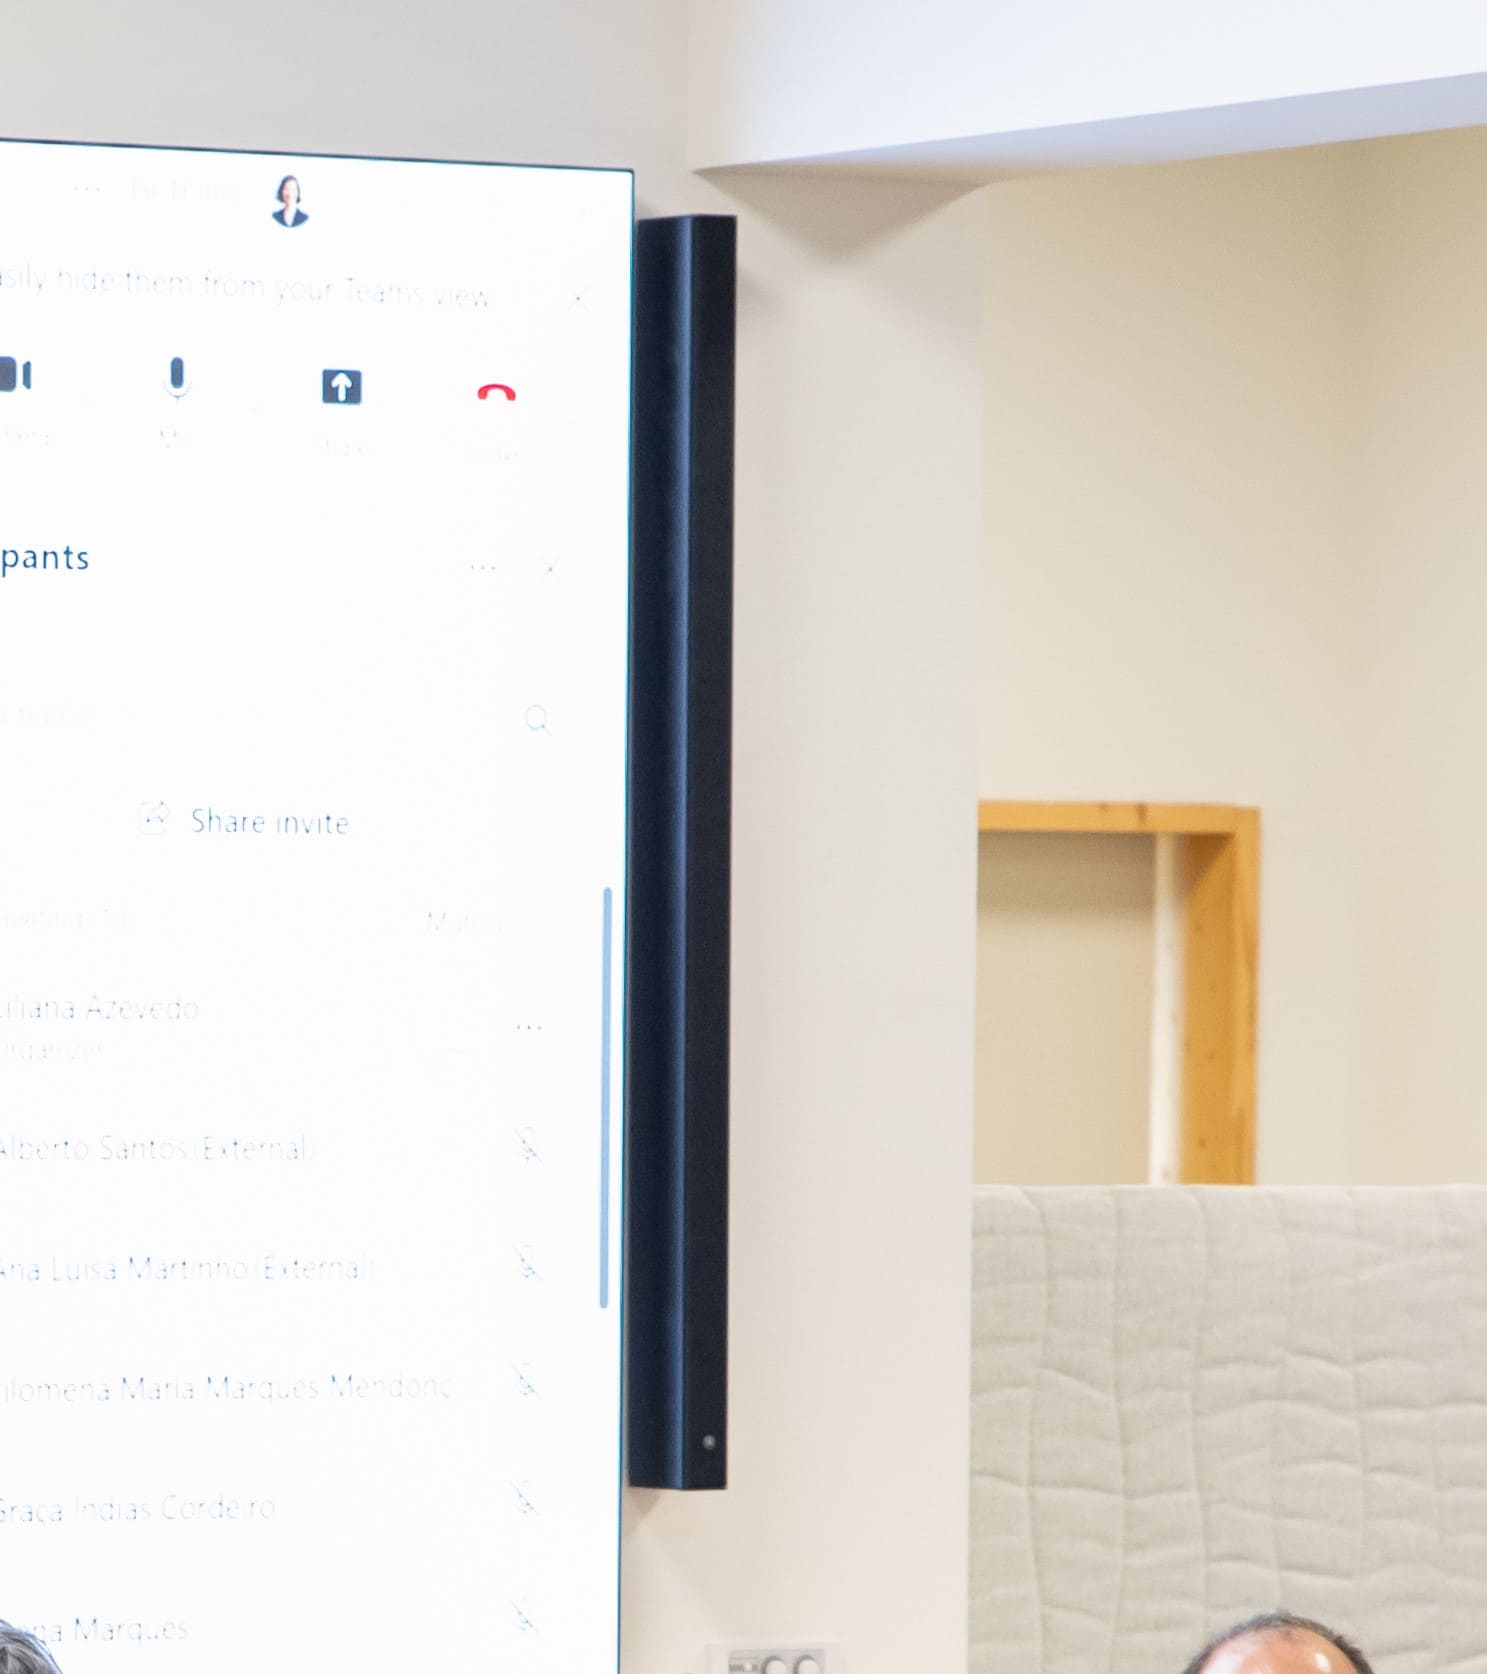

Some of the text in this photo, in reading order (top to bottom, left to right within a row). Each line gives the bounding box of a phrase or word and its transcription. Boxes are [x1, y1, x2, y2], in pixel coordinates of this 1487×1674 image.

[57, 264, 115, 292] hide
[191, 805, 350, 837] Share invite
